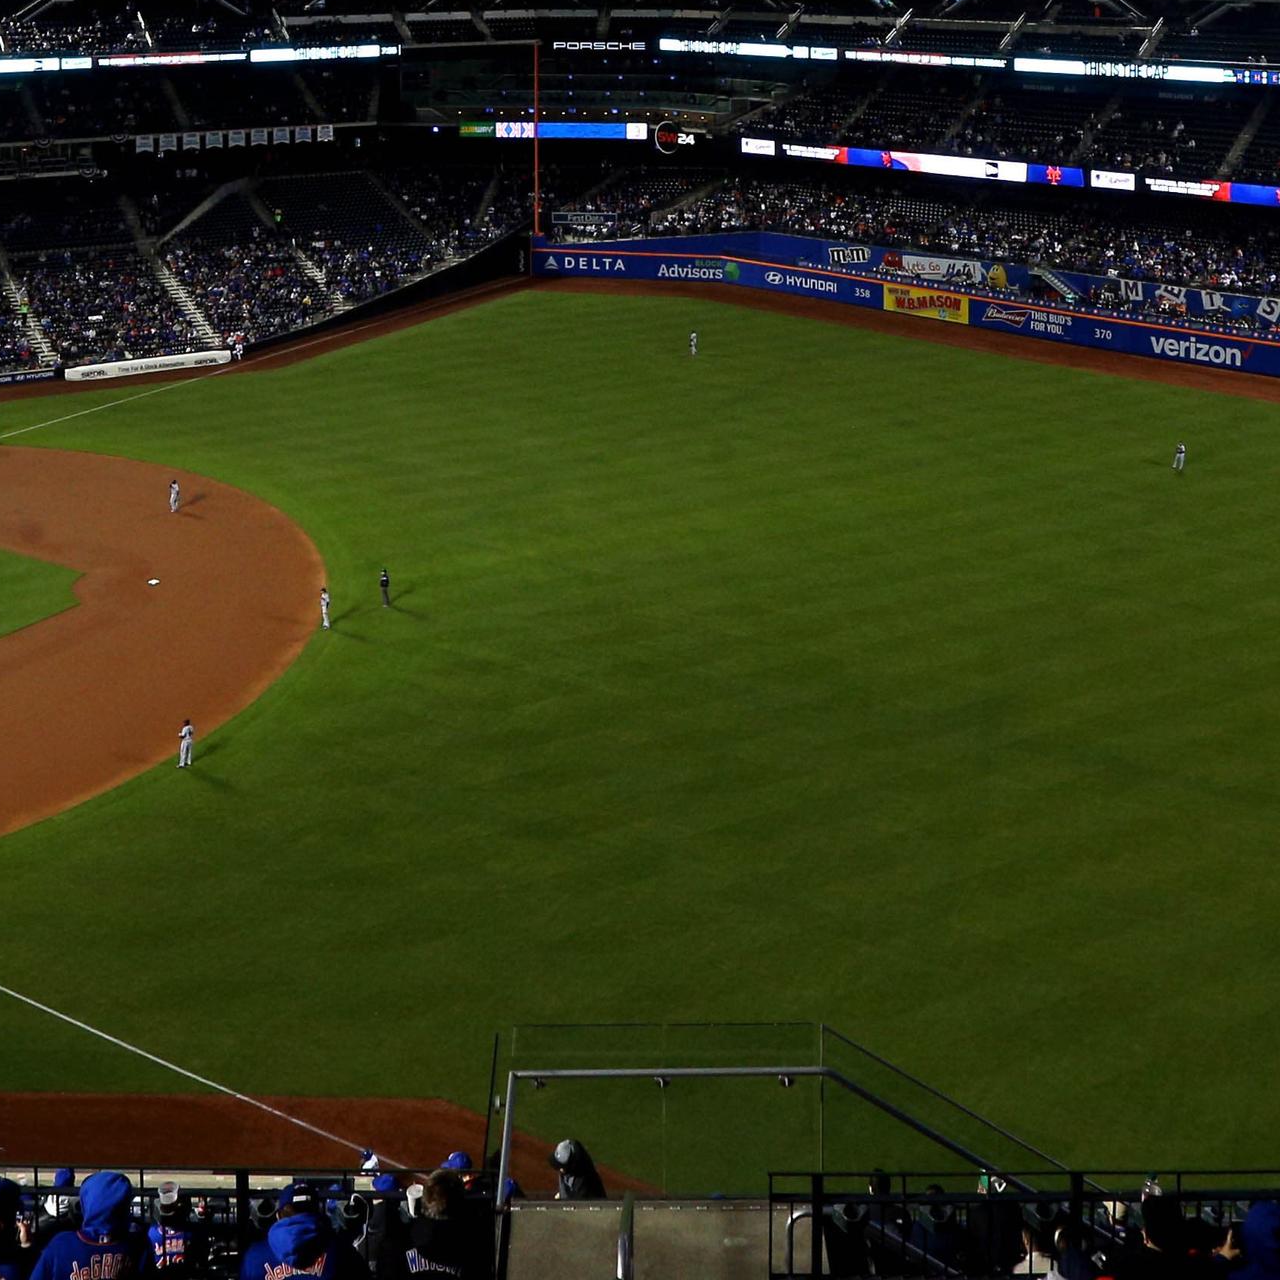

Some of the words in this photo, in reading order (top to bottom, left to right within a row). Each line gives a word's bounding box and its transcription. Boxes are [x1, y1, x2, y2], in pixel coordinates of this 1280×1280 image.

[553, 41, 646, 51] PORSCHE
[564, 256, 626, 271] DELTA
[929, 261, 940, 272] Go
[658, 263, 723, 280] Advisors
[786, 275, 837, 293] HYUNDAI
[854, 287, 871, 298] 358
[988, 307, 1025, 322] Budweiser
[1031, 310, 1048, 322] THIS
[1048, 314, 1073, 326] BUD'S
[1030, 321, 1046, 332] FOR
[1047, 323, 1065, 335] YOU.
[1094, 328, 1112, 340] 370
[1150, 335, 1241, 366] verizon
